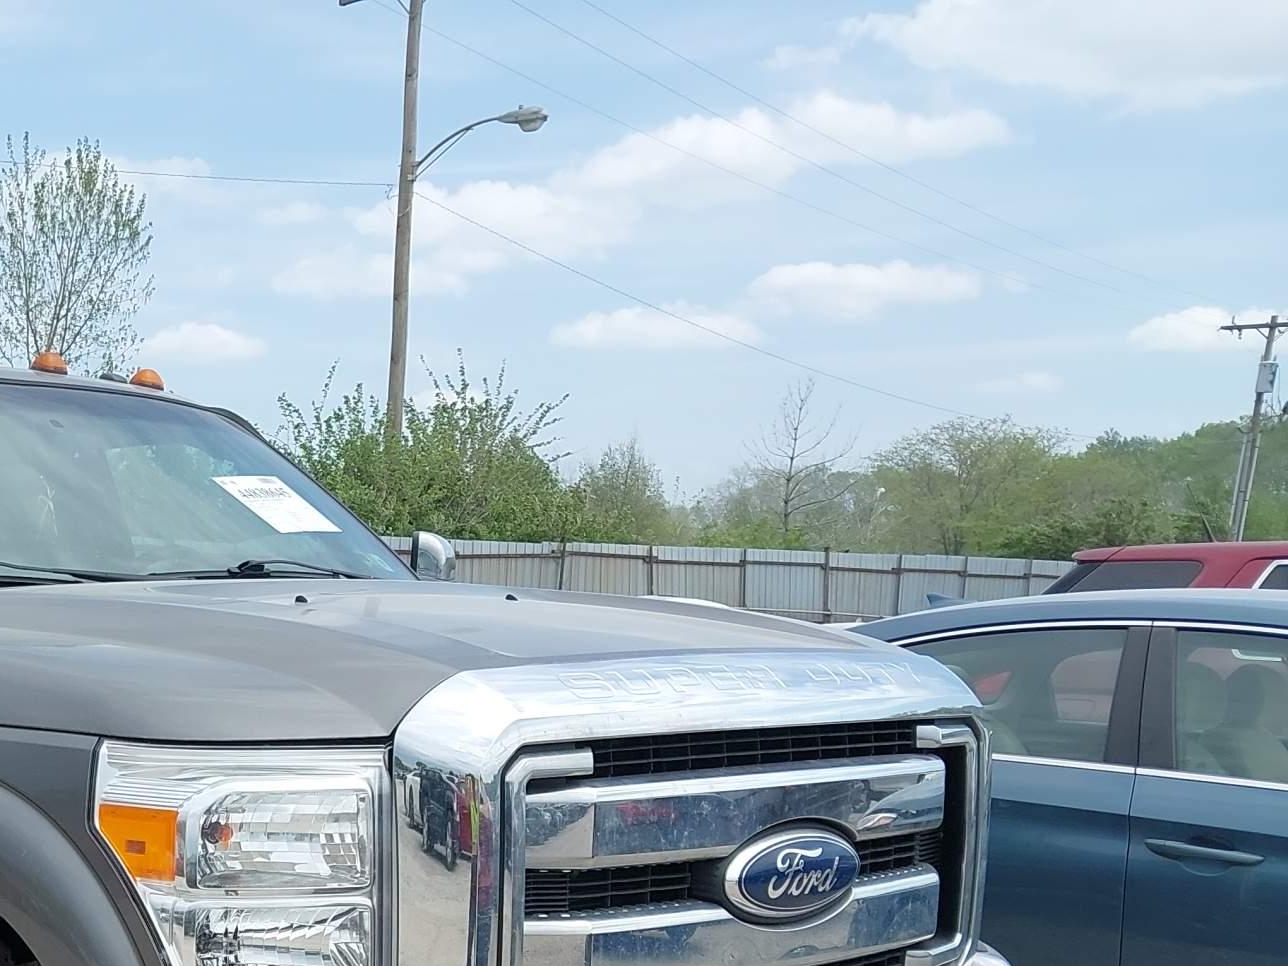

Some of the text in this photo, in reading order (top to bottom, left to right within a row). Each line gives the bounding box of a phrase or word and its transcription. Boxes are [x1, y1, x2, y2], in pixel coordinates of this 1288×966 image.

[557, 661, 922, 699] SUPER DUTY
[768, 848, 840, 899] Ford
